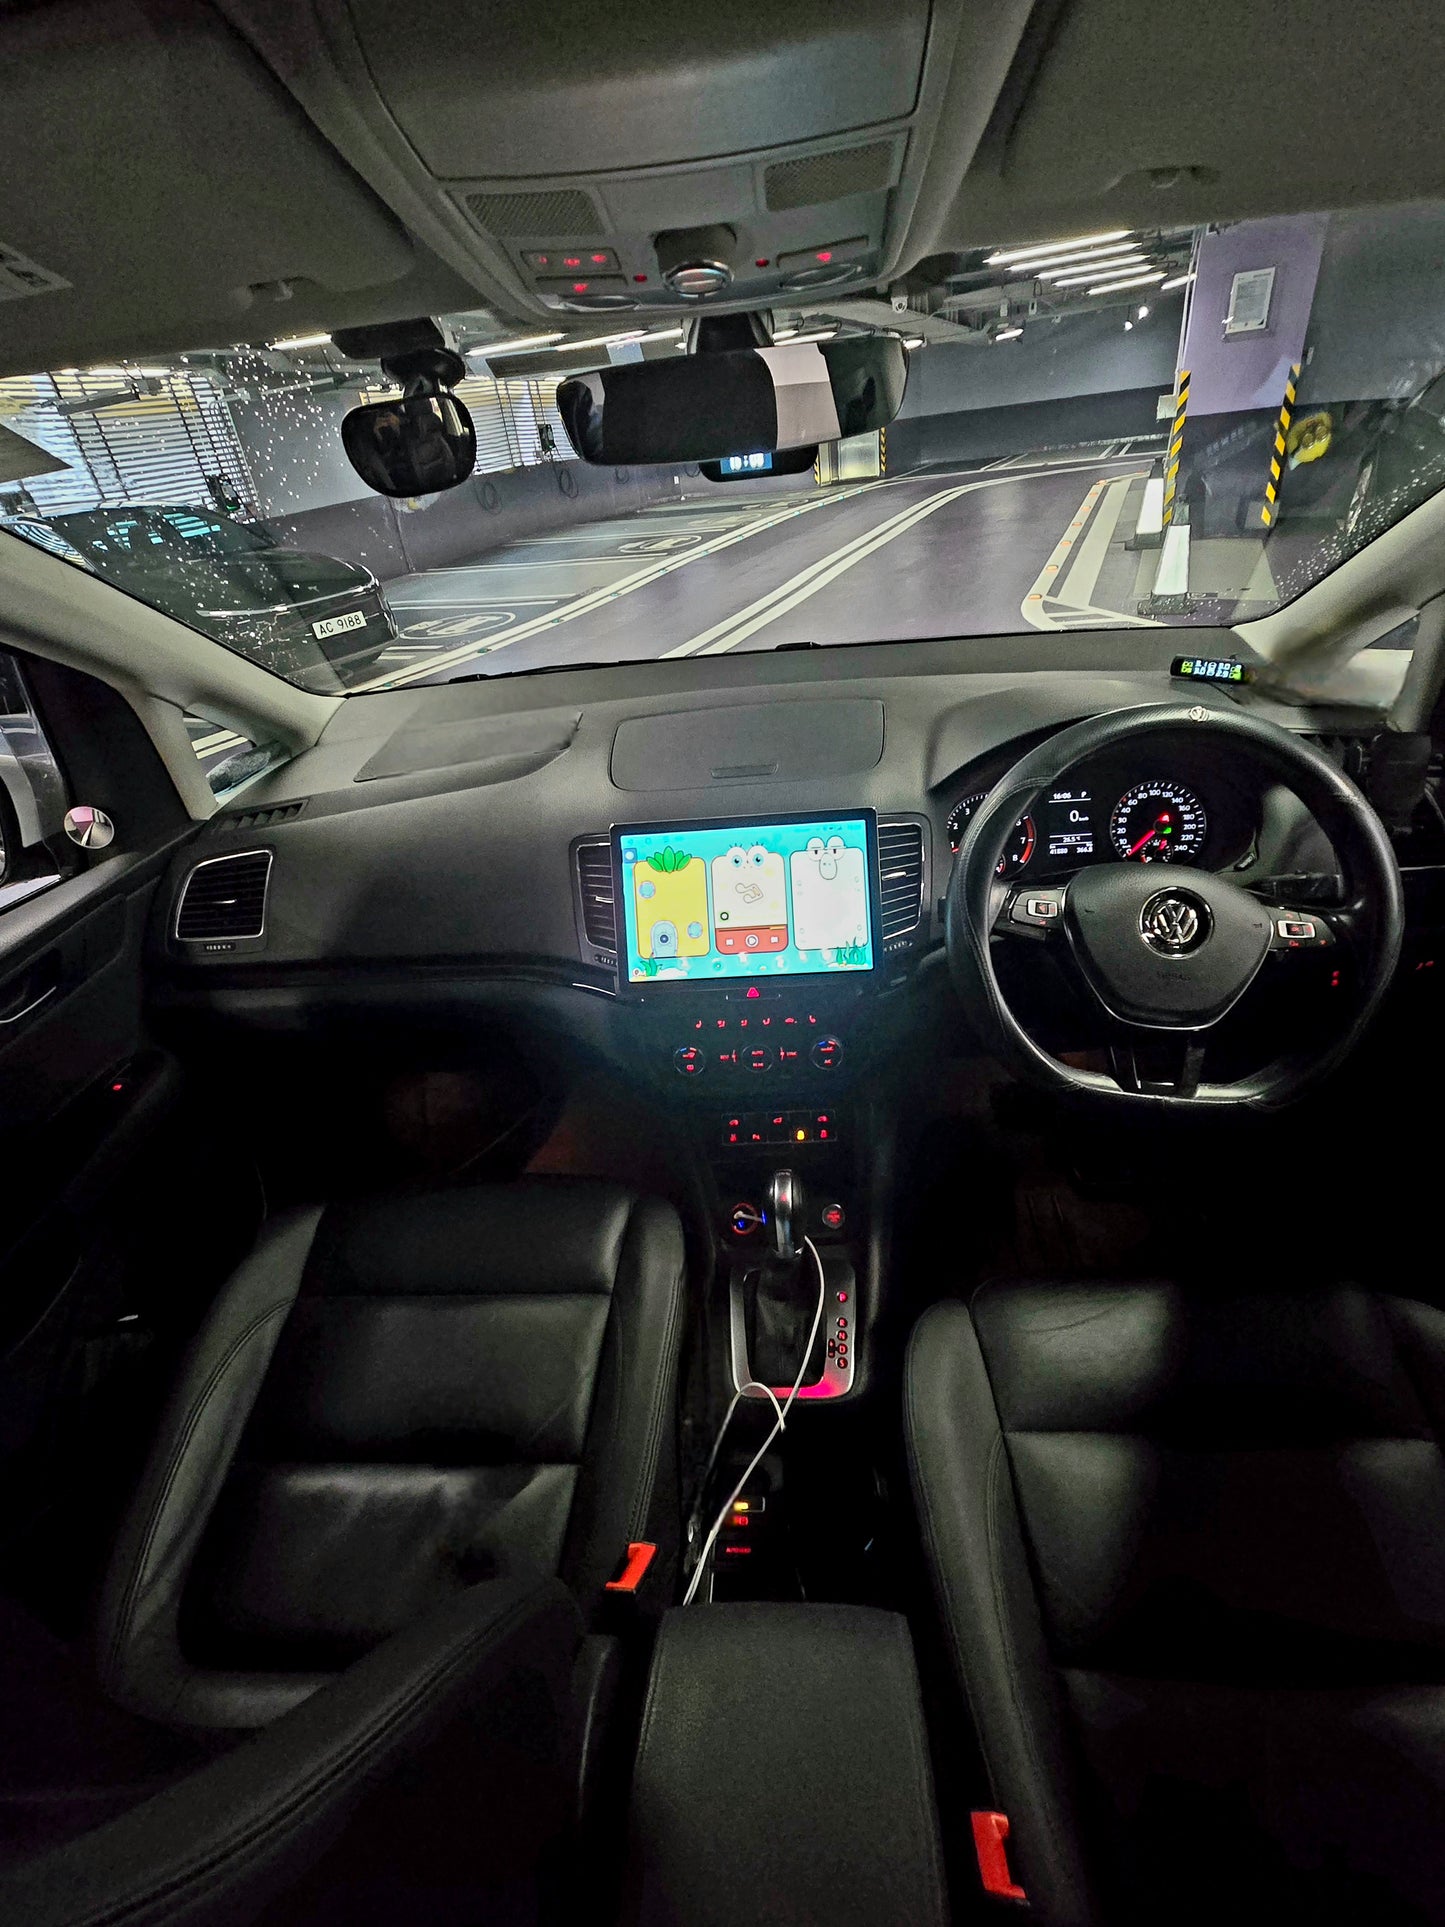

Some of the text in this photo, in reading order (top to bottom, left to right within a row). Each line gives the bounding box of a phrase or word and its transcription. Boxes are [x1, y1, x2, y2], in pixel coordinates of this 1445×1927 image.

[319, 614, 361, 635] AC 9188
[965, 807, 970, 815] 3
[1069, 809, 1080, 823] 0
[953, 822, 958, 830] 2
[1116, 827, 1126, 835] 20
[1012, 854, 1018, 862] 8
[839, 1293, 846, 1302] P
[839, 1345, 846, 1353] D
[839, 1359, 846, 1367] S
